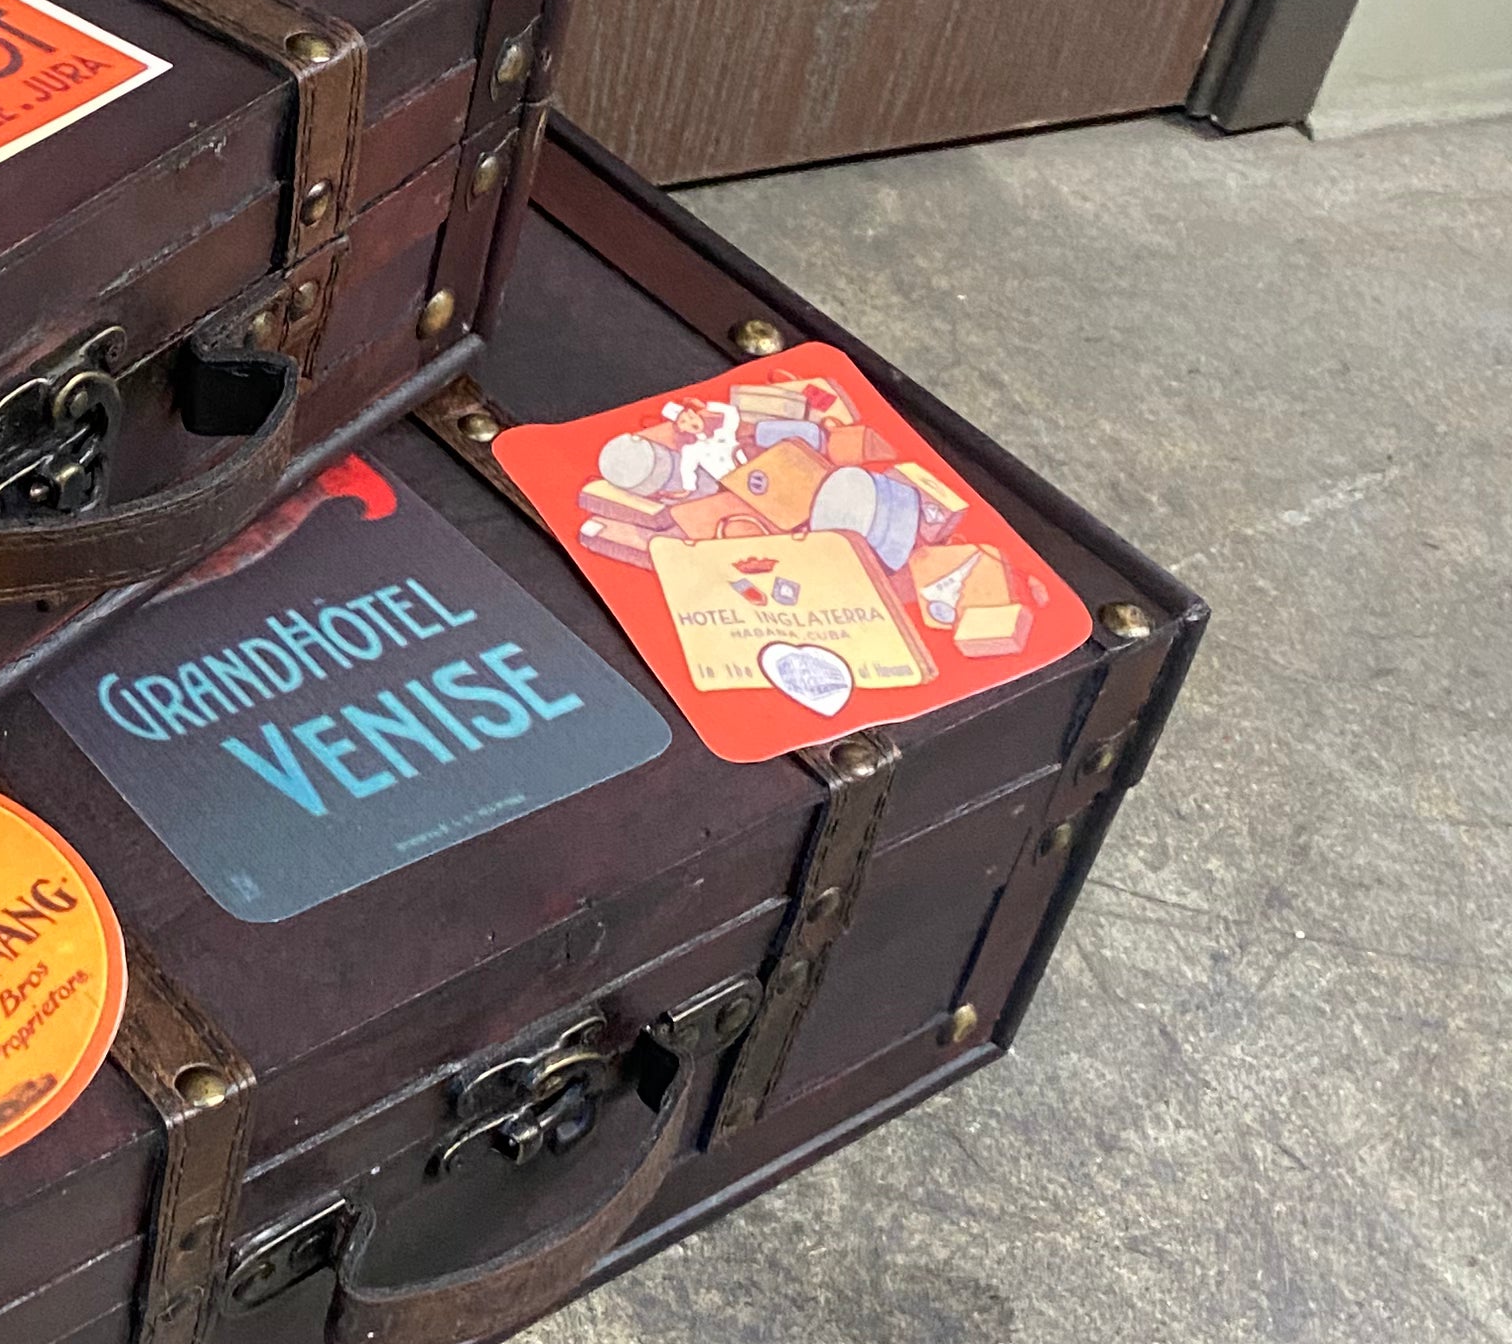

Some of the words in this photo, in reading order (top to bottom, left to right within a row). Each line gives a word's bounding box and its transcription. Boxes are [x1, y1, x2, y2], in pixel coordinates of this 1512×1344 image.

[23, 55, 112, 103] JURA
[678, 608, 745, 627] HOTEL
[755, 606, 886, 628] INGLATERRA
[806, 629, 851, 641] CUBA
[219, 642, 585, 817] VENISE
[0, 960, 49, 1019] Bros
